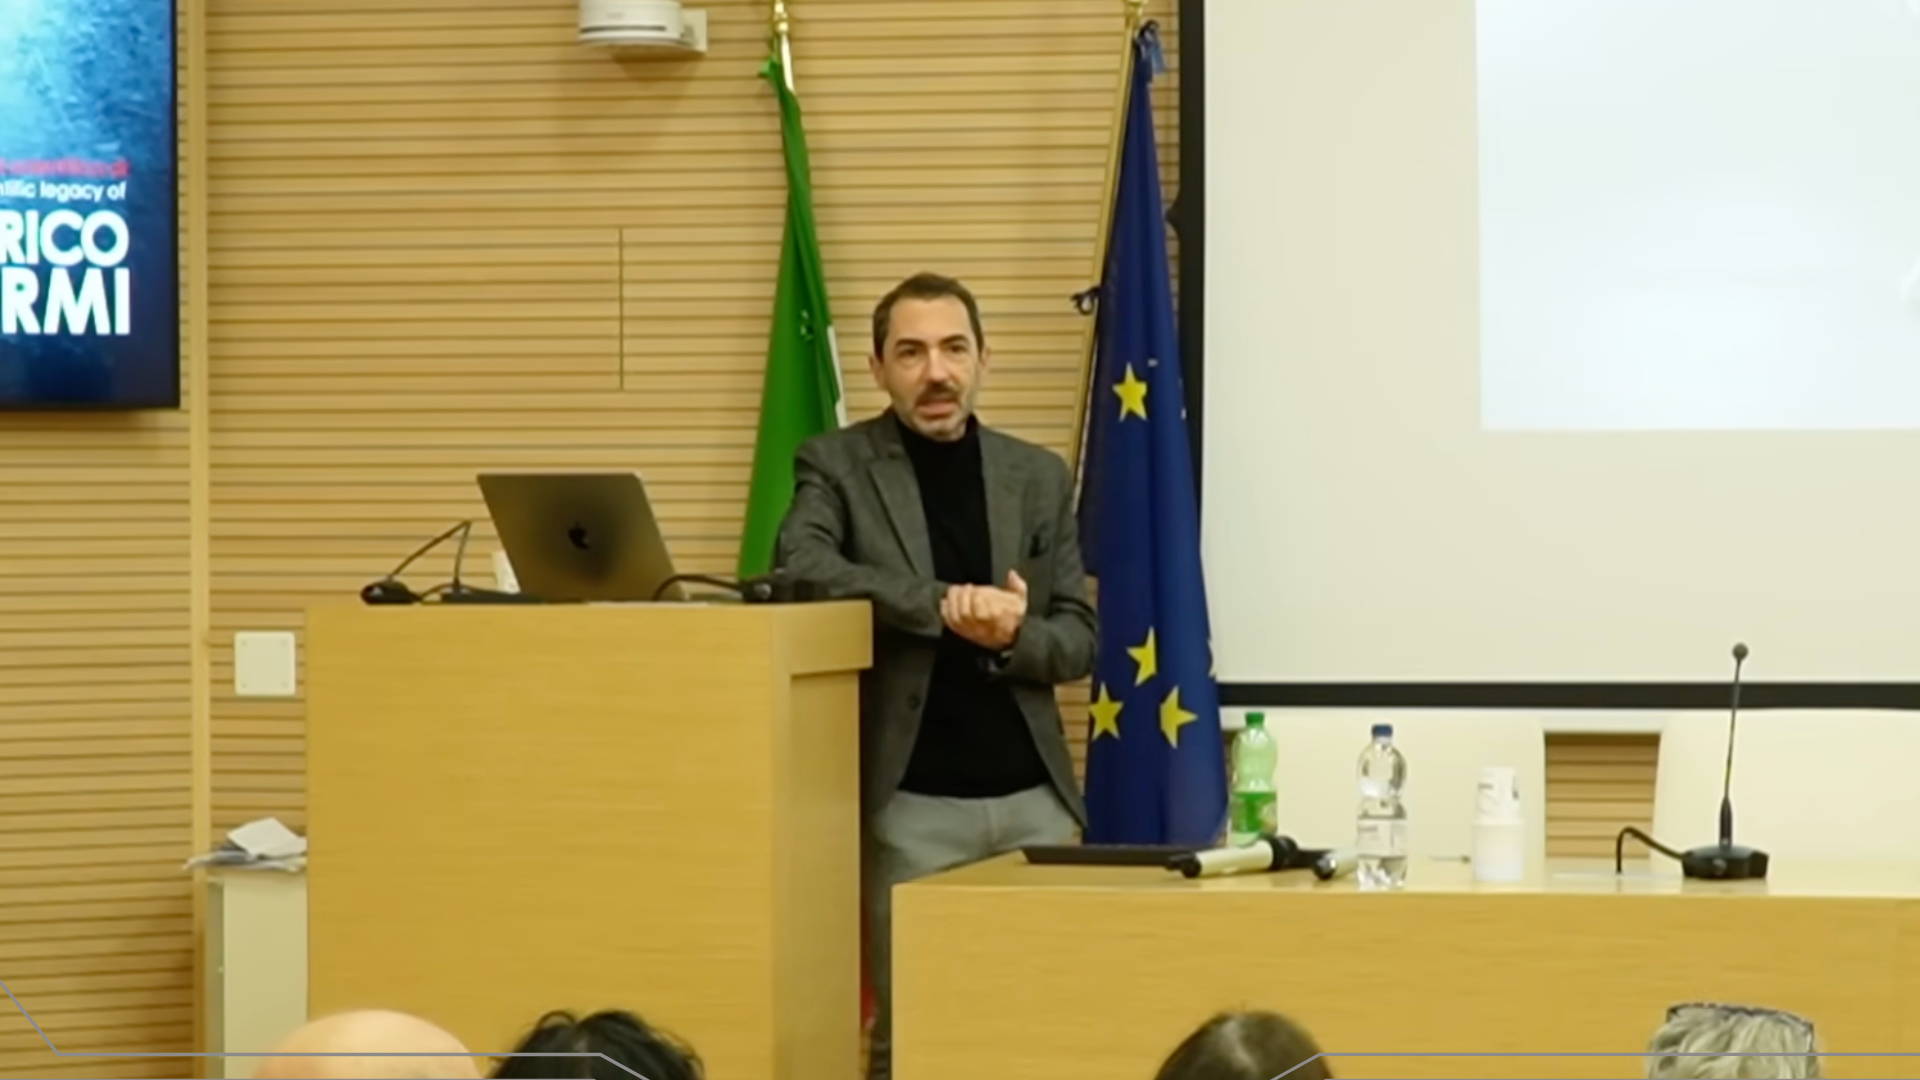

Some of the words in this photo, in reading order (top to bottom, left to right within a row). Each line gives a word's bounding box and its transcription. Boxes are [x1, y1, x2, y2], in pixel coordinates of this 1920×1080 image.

[40, 180, 104, 203] legacy
[106, 180, 127, 200] of
[0, 208, 129, 267] RICO
[1, 266, 130, 335] RMI
